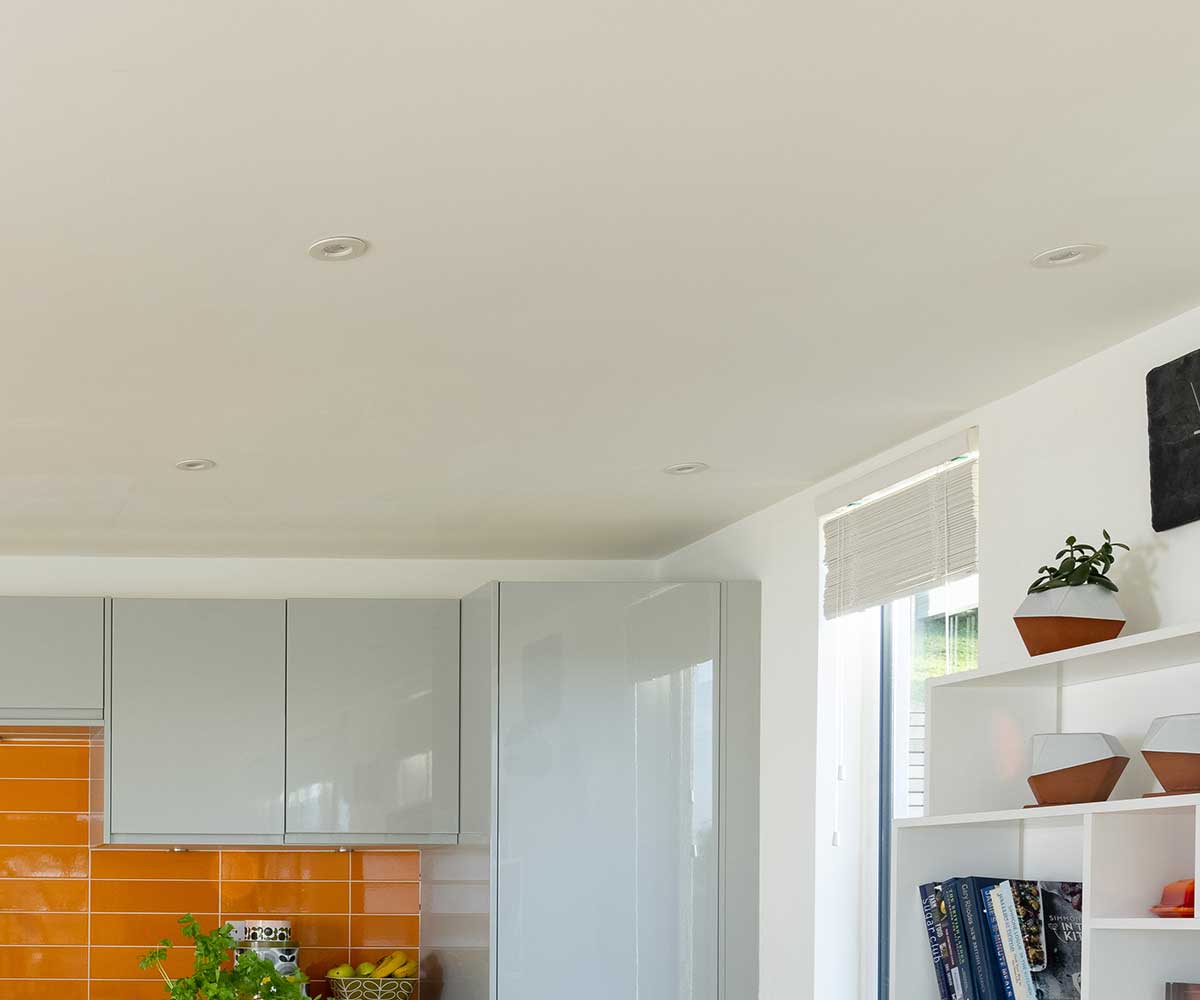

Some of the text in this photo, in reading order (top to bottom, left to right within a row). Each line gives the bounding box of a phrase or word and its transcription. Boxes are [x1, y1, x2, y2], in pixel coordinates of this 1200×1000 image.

[960, 883, 969, 900] Gary
[964, 900, 973, 925] Rhodes
[1061, 922, 1073, 931] IN
[930, 936, 941, 963] club
